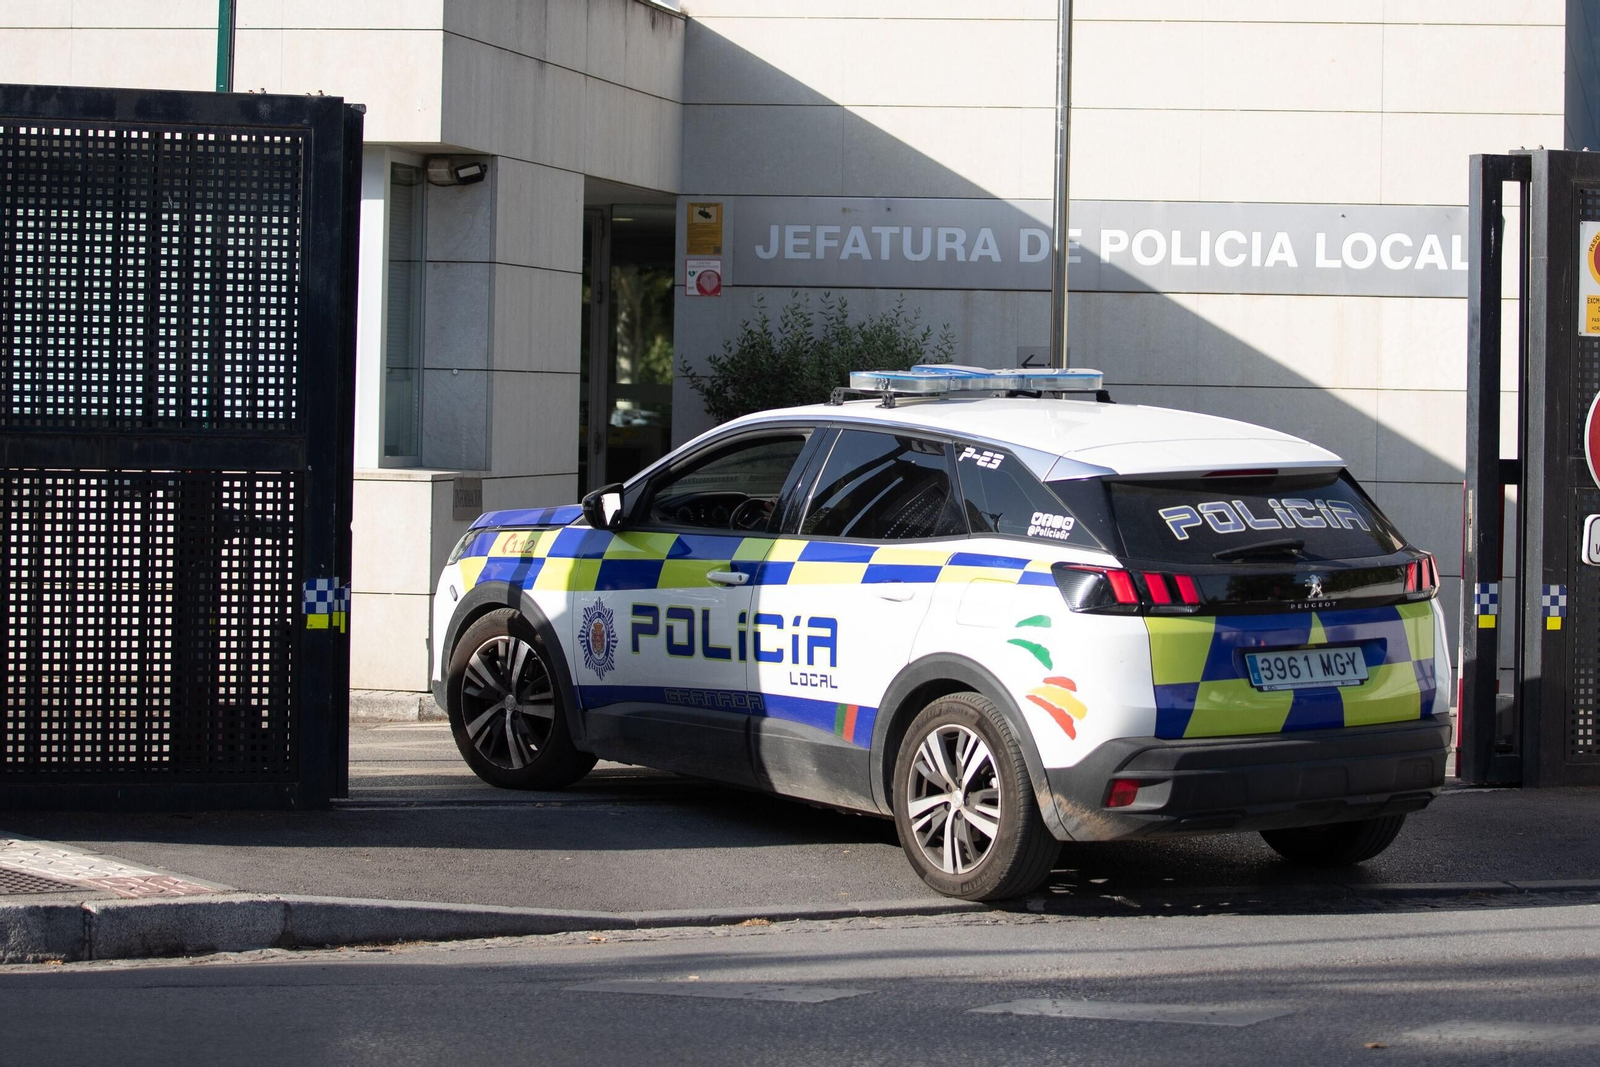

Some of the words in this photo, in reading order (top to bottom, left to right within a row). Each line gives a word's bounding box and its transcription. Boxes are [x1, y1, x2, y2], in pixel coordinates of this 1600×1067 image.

[754, 224, 1003, 263] JEFATURA
[1100, 228, 1298, 268] POLICIA
[1315, 231, 1469, 271] LOCAL
[958, 447, 1005, 470] P-23
[1027, 525, 1070, 540] @PoliciaGr
[509, 539, 535, 554] 112
[1290, 601, 1337, 609] PEUGEOT
[1260, 654, 1314, 681] 3961
[1319, 651, 1358, 677] MGY
[789, 671, 839, 690] LOCAL
[663, 687, 764, 711] GRANADA
